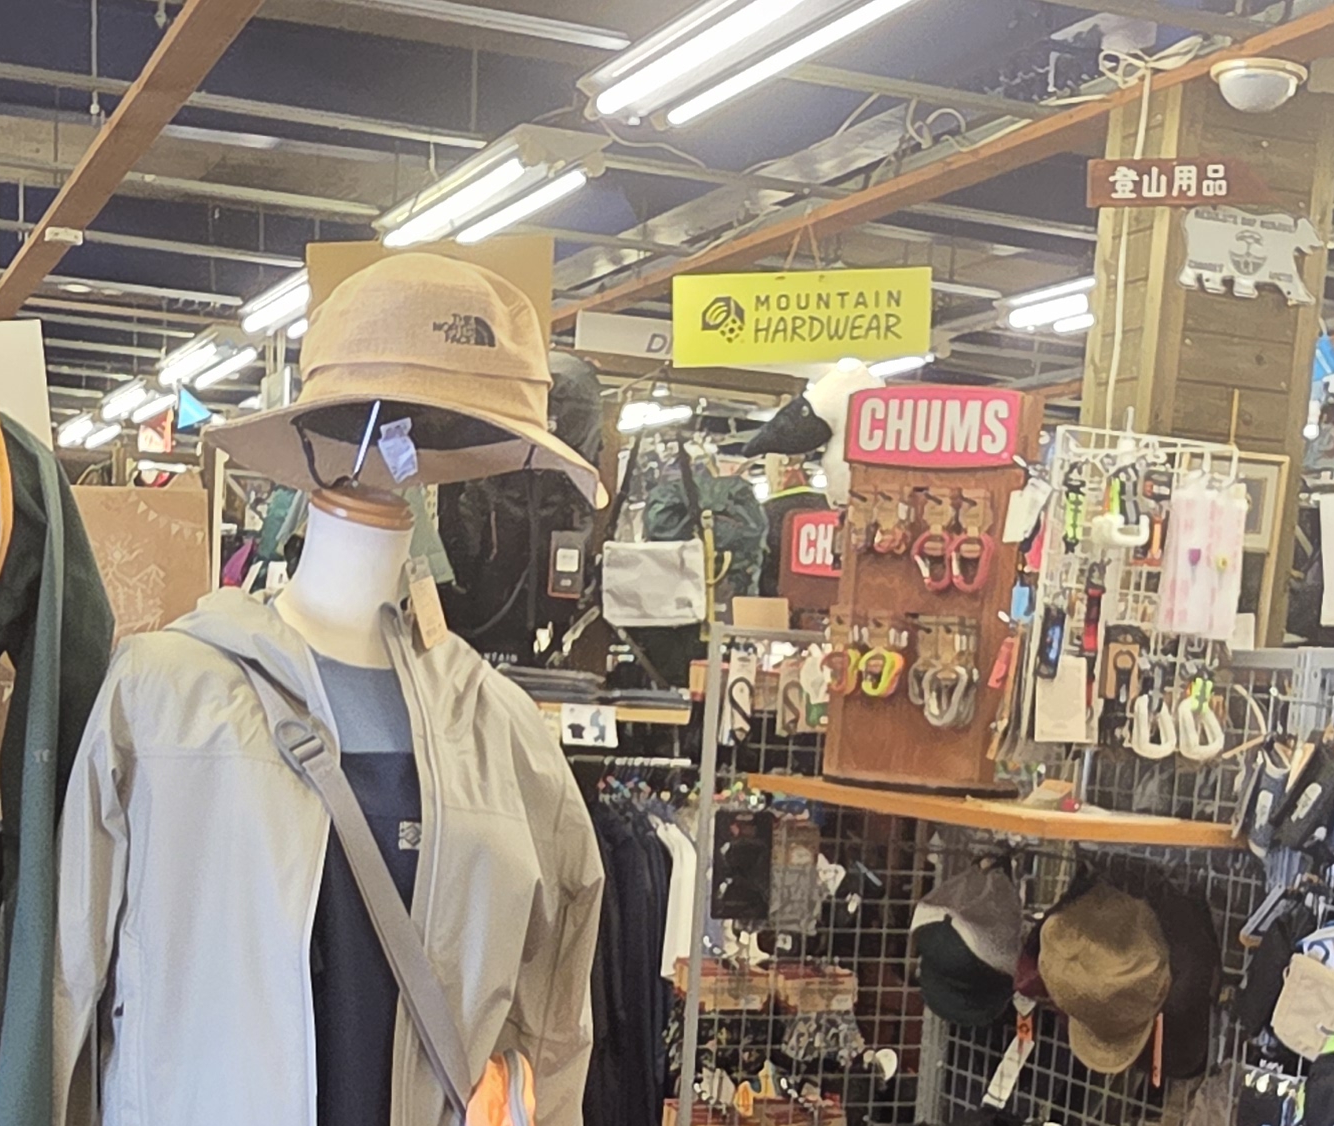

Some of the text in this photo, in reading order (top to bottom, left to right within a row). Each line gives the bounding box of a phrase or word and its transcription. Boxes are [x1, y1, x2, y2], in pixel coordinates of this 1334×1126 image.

[1108, 164, 1227, 198] 登山用品
[755, 290, 902, 311] MOUNTAIN
[755, 314, 902, 343] HARDWEAR
[858, 397, 1009, 454] CHUMS
[799, 523, 834, 565] CH
